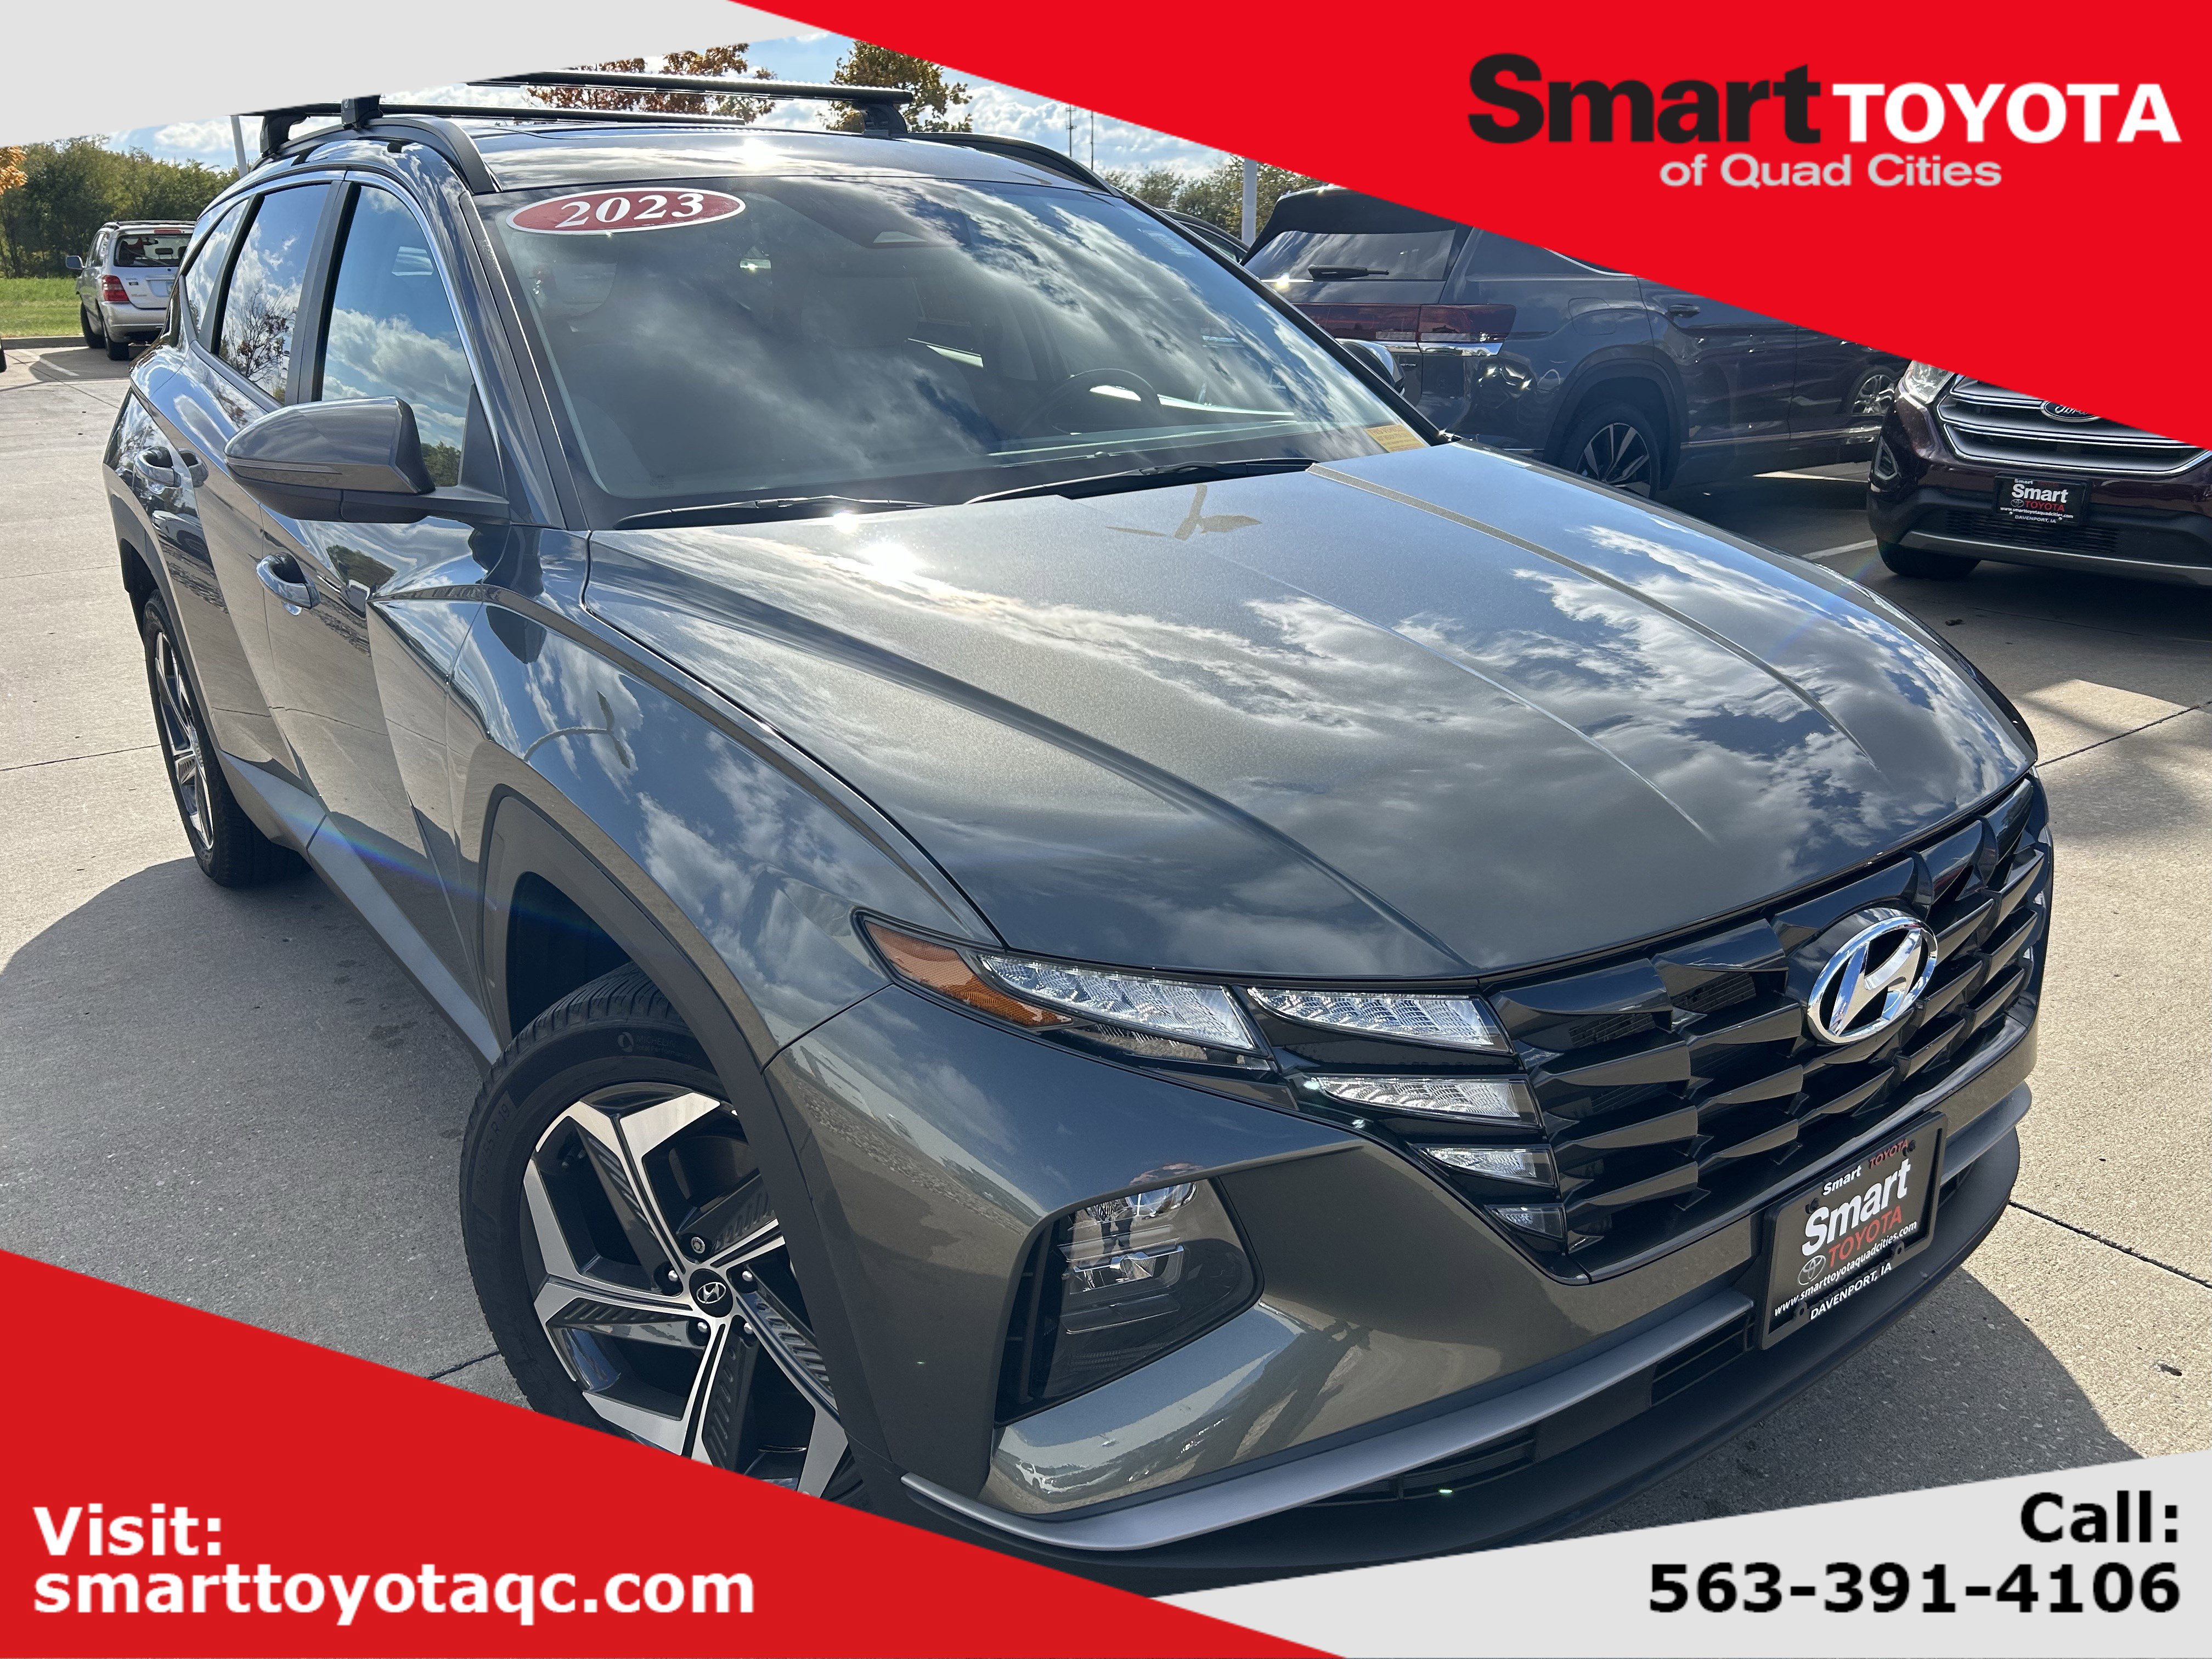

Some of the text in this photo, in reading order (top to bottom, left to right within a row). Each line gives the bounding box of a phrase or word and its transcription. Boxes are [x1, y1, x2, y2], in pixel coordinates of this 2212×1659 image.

[555, 193, 704, 228] 2023
[2012, 484, 2068, 503] Smart
[2025, 500, 2065, 512] TOYOTA
[636, 1035, 676, 1048] MICHELIN
[498, 1103, 511, 1122] 19
[1823, 1138, 1909, 1196] Smart TOYOTA
[1802, 1158, 1911, 1256] Smart
[1829, 1204, 1903, 1268] TOYOTA
[1774, 1221, 1917, 1317] www.smarttoyotaquadcities.com
[1810, 1262, 1892, 1321] DAVENPORT, IA
